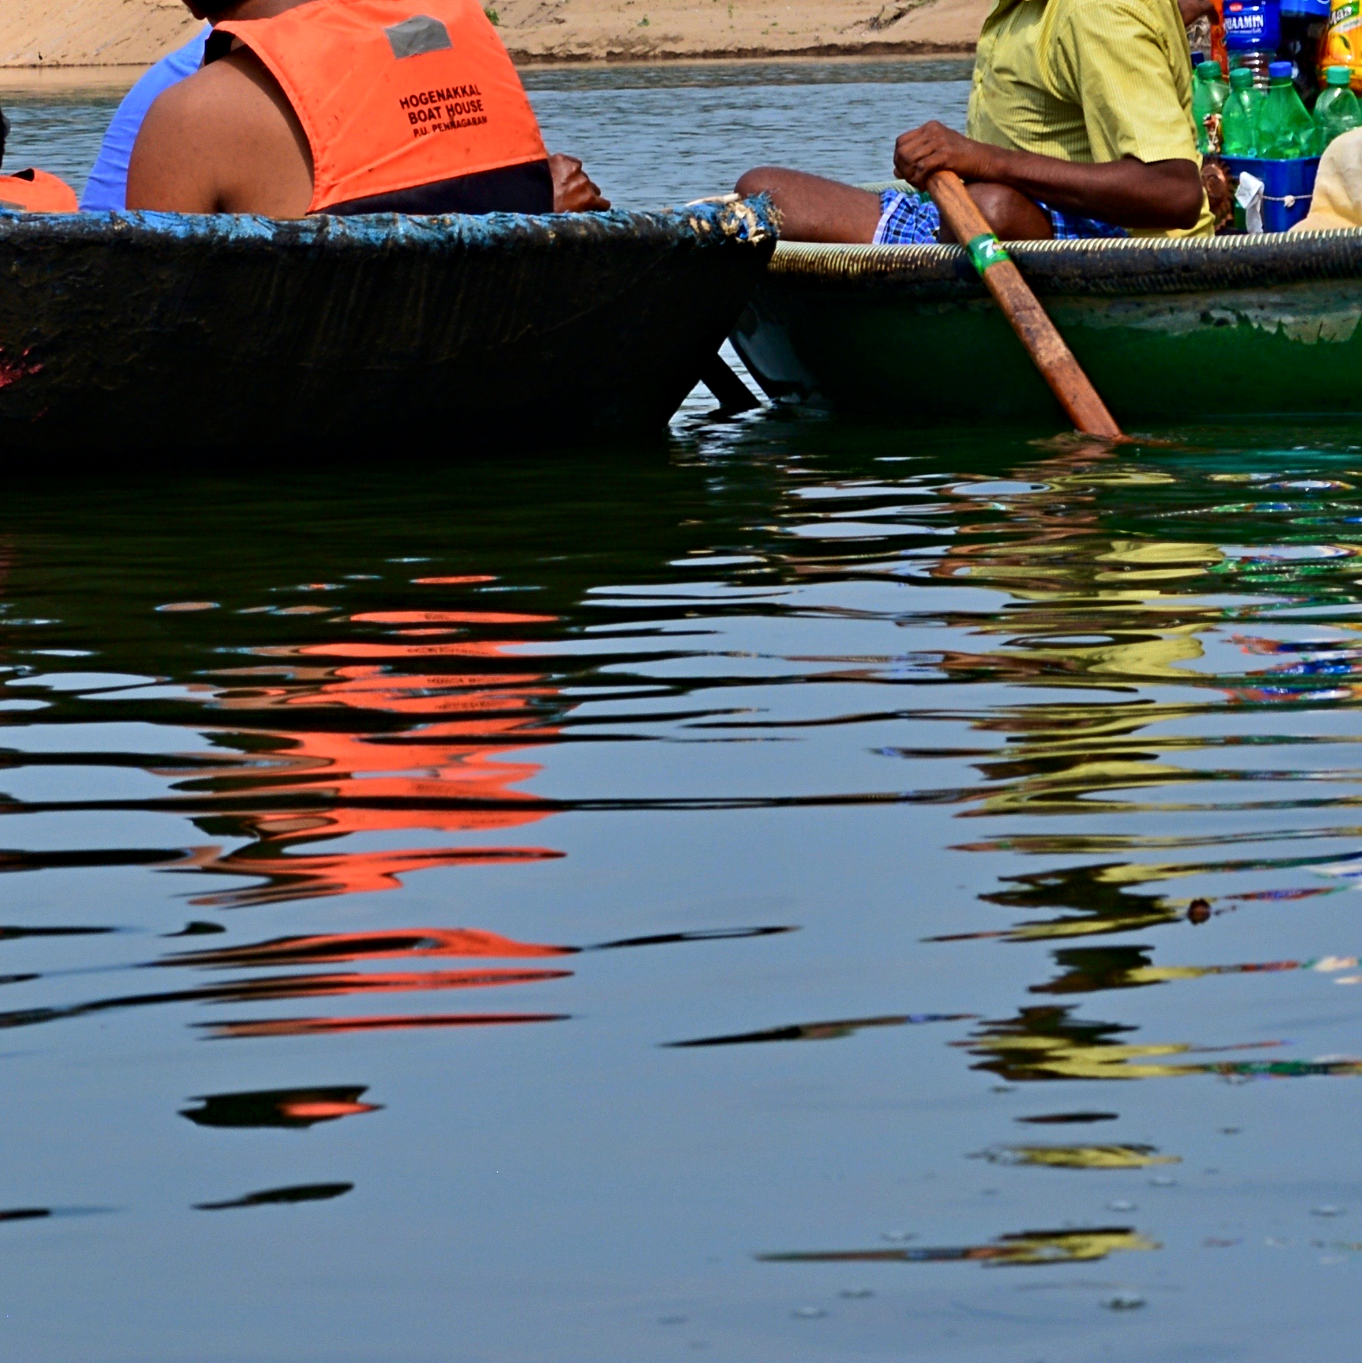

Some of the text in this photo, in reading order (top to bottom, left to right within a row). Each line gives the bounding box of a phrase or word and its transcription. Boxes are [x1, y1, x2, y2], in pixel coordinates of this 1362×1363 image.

[399, 83, 482, 110] HOGENAKKAL
[408, 99, 484, 126] BOAT HOUSE
